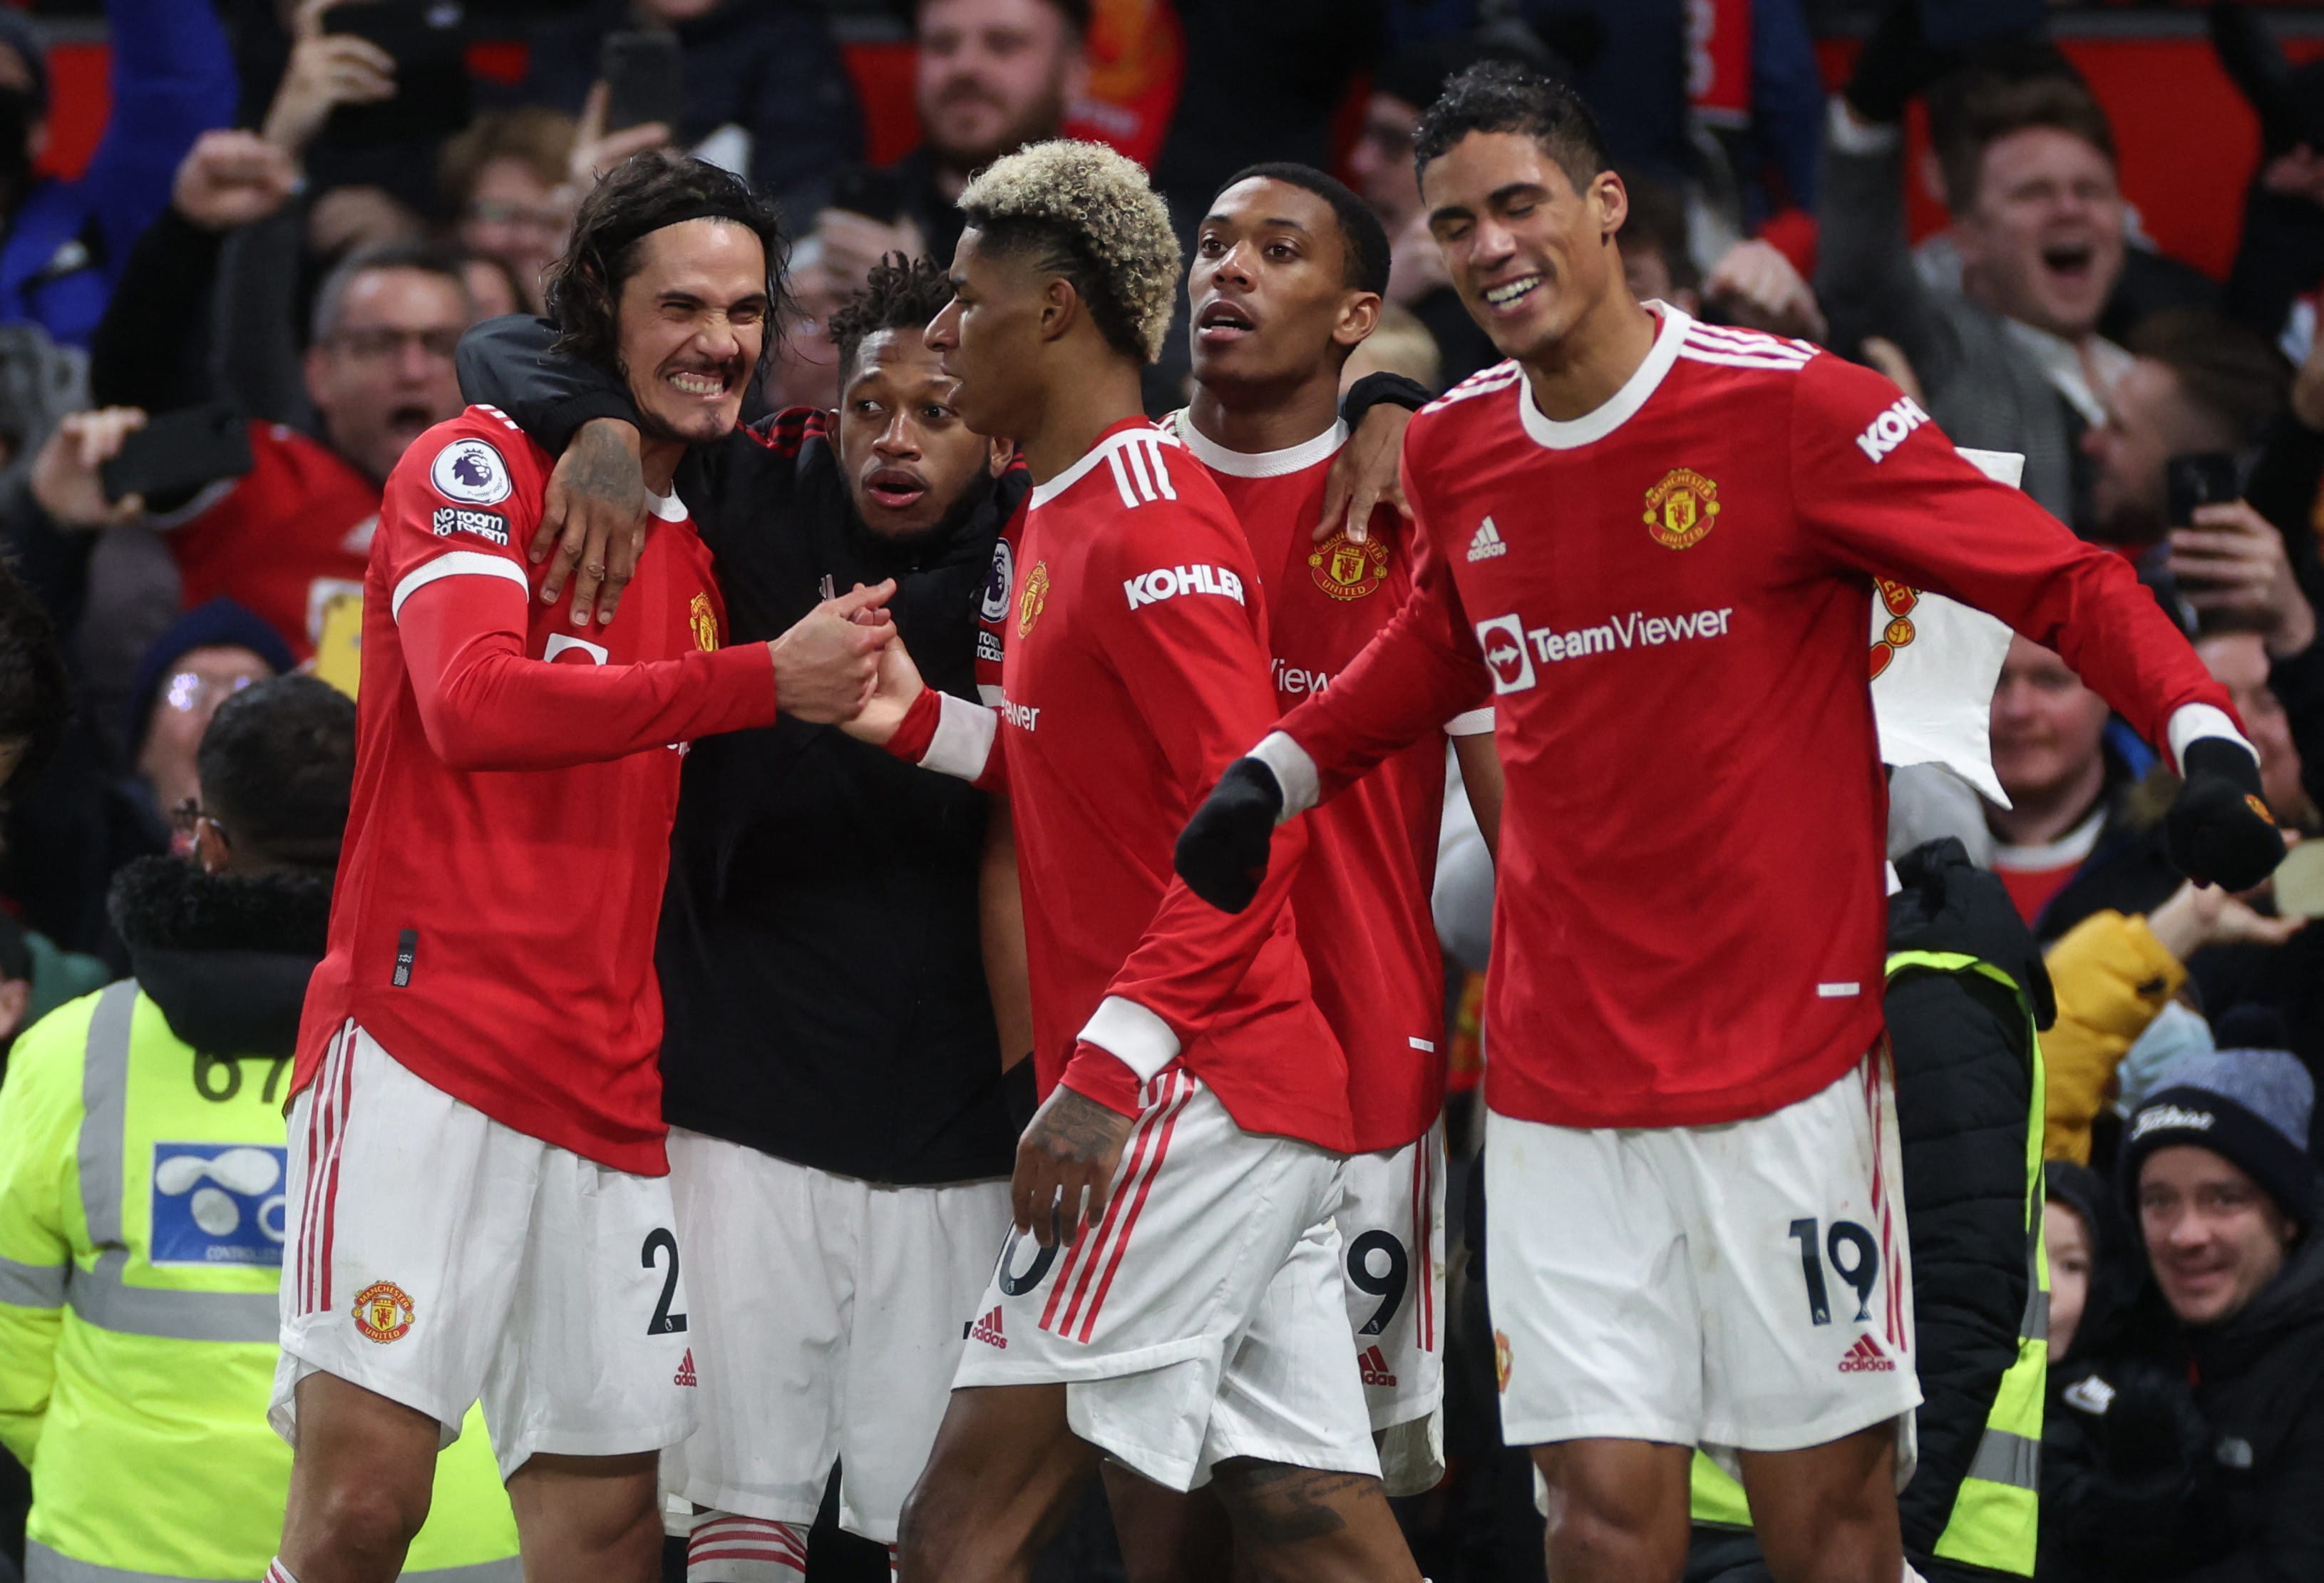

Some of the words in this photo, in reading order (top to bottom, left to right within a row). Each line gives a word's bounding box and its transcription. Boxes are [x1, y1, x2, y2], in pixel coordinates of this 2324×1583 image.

[1650, 476, 1712, 503] MANCHESTER
[433, 508, 455, 526] No
[456, 511, 503, 531] room
[433, 521, 454, 536] for
[457, 521, 508, 546] racism
[1662, 527, 1703, 543] UNITED
[1466, 542, 1506, 562] adidas
[1124, 565, 1245, 610] KOHLER
[1322, 579, 1366, 595] UNITED
[1528, 608, 1733, 664] TeamViewer
[642, 1227, 687, 1335] 2
[1347, 1229, 1409, 1336] 9
[1789, 1216, 1880, 1327] 19
[359, 1285, 410, 1308] MANCHESTER
[364, 1327, 400, 1339] UNITED
[972, 1326, 1008, 1349] adidas
[1838, 1355, 1896, 1373] adidas
